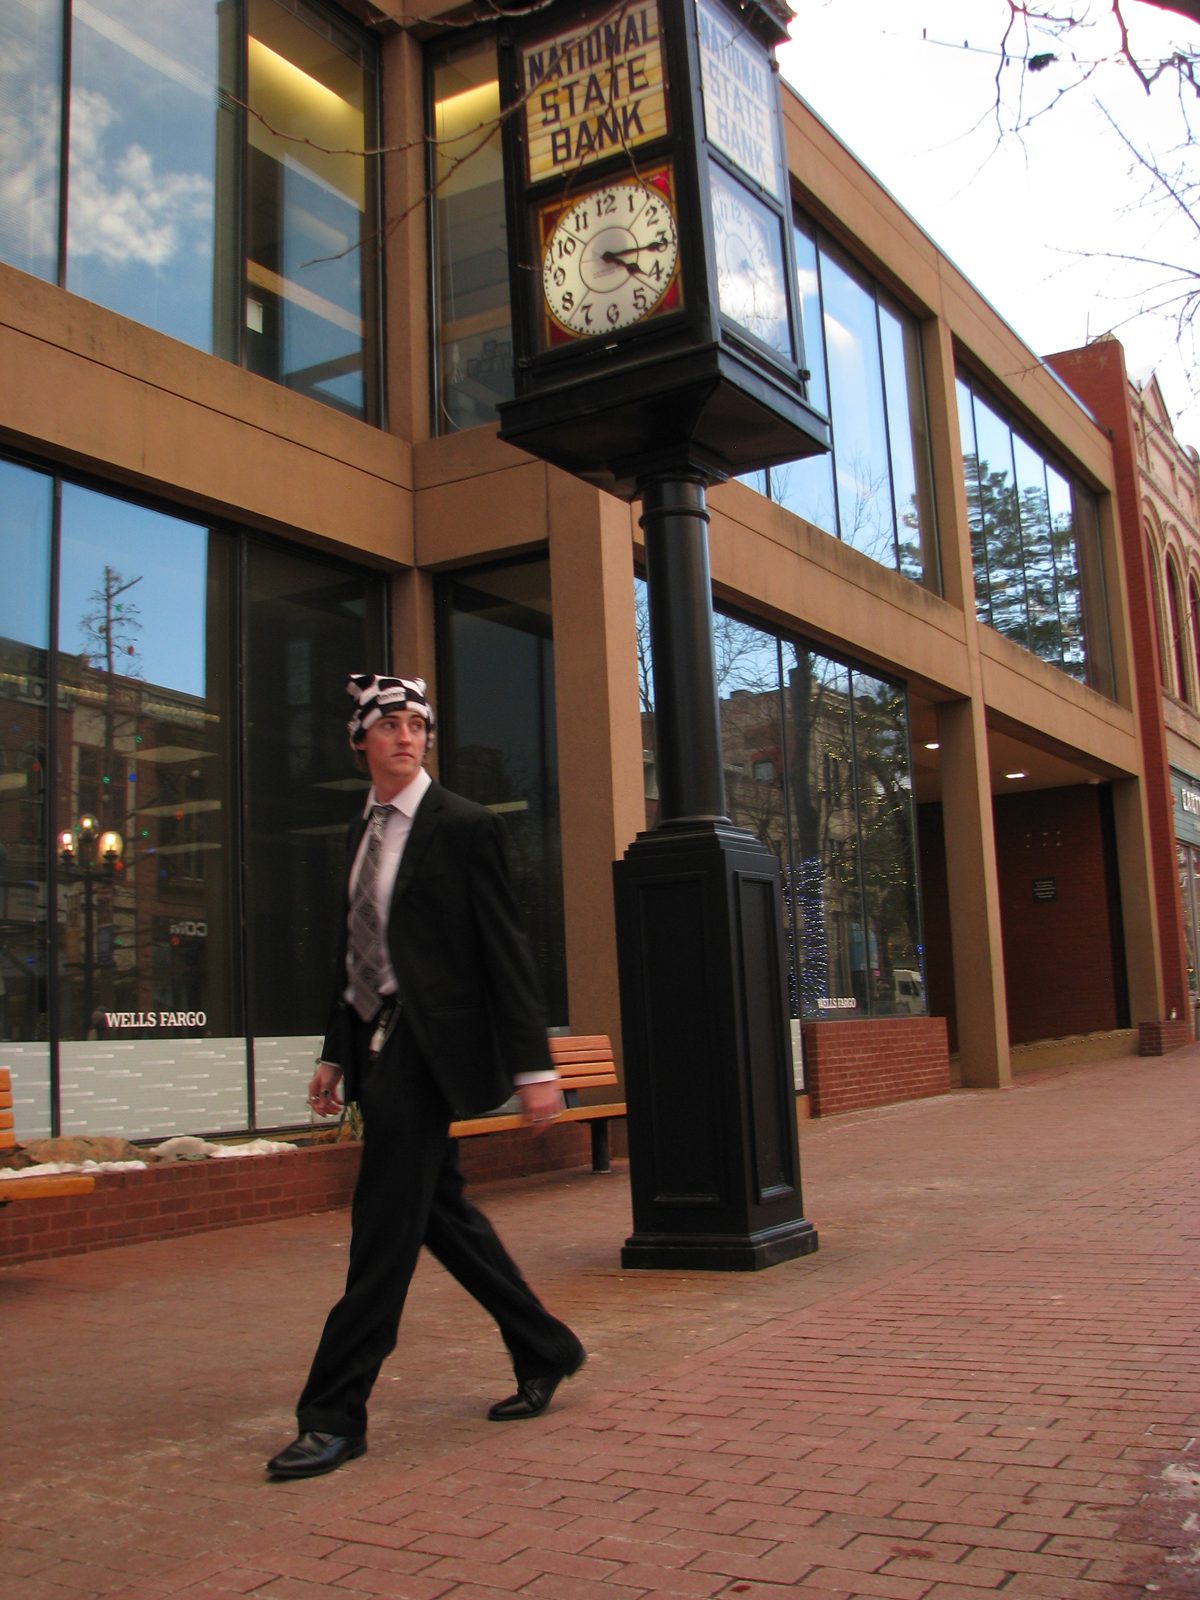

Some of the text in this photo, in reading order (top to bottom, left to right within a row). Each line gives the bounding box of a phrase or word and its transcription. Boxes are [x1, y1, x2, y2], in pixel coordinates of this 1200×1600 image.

[528, 10, 658, 88] NATIONAL
[540, 54, 649, 127] STATE
[708, 57, 767, 143] STATE
[551, 99, 645, 166] BANK
[716, 105, 767, 181] BANK
[595, 193, 618, 217] 12
[627, 193, 635, 213] 1
[574, 210, 590, 232] 11
[645, 206, 660, 227] 2
[557, 236, 576, 259] 10
[655, 230, 668, 253] 3
[553, 267, 566, 287] 9
[649, 259, 665, 281] 4
[561, 290, 574, 312] 8
[633, 288, 647, 310] 5
[581, 303, 594, 326] 7
[606, 303, 620, 325] 6
[817, 997, 857, 1009] WELLS FARGO
[104, 1011, 207, 1027] WELLS FARGO
